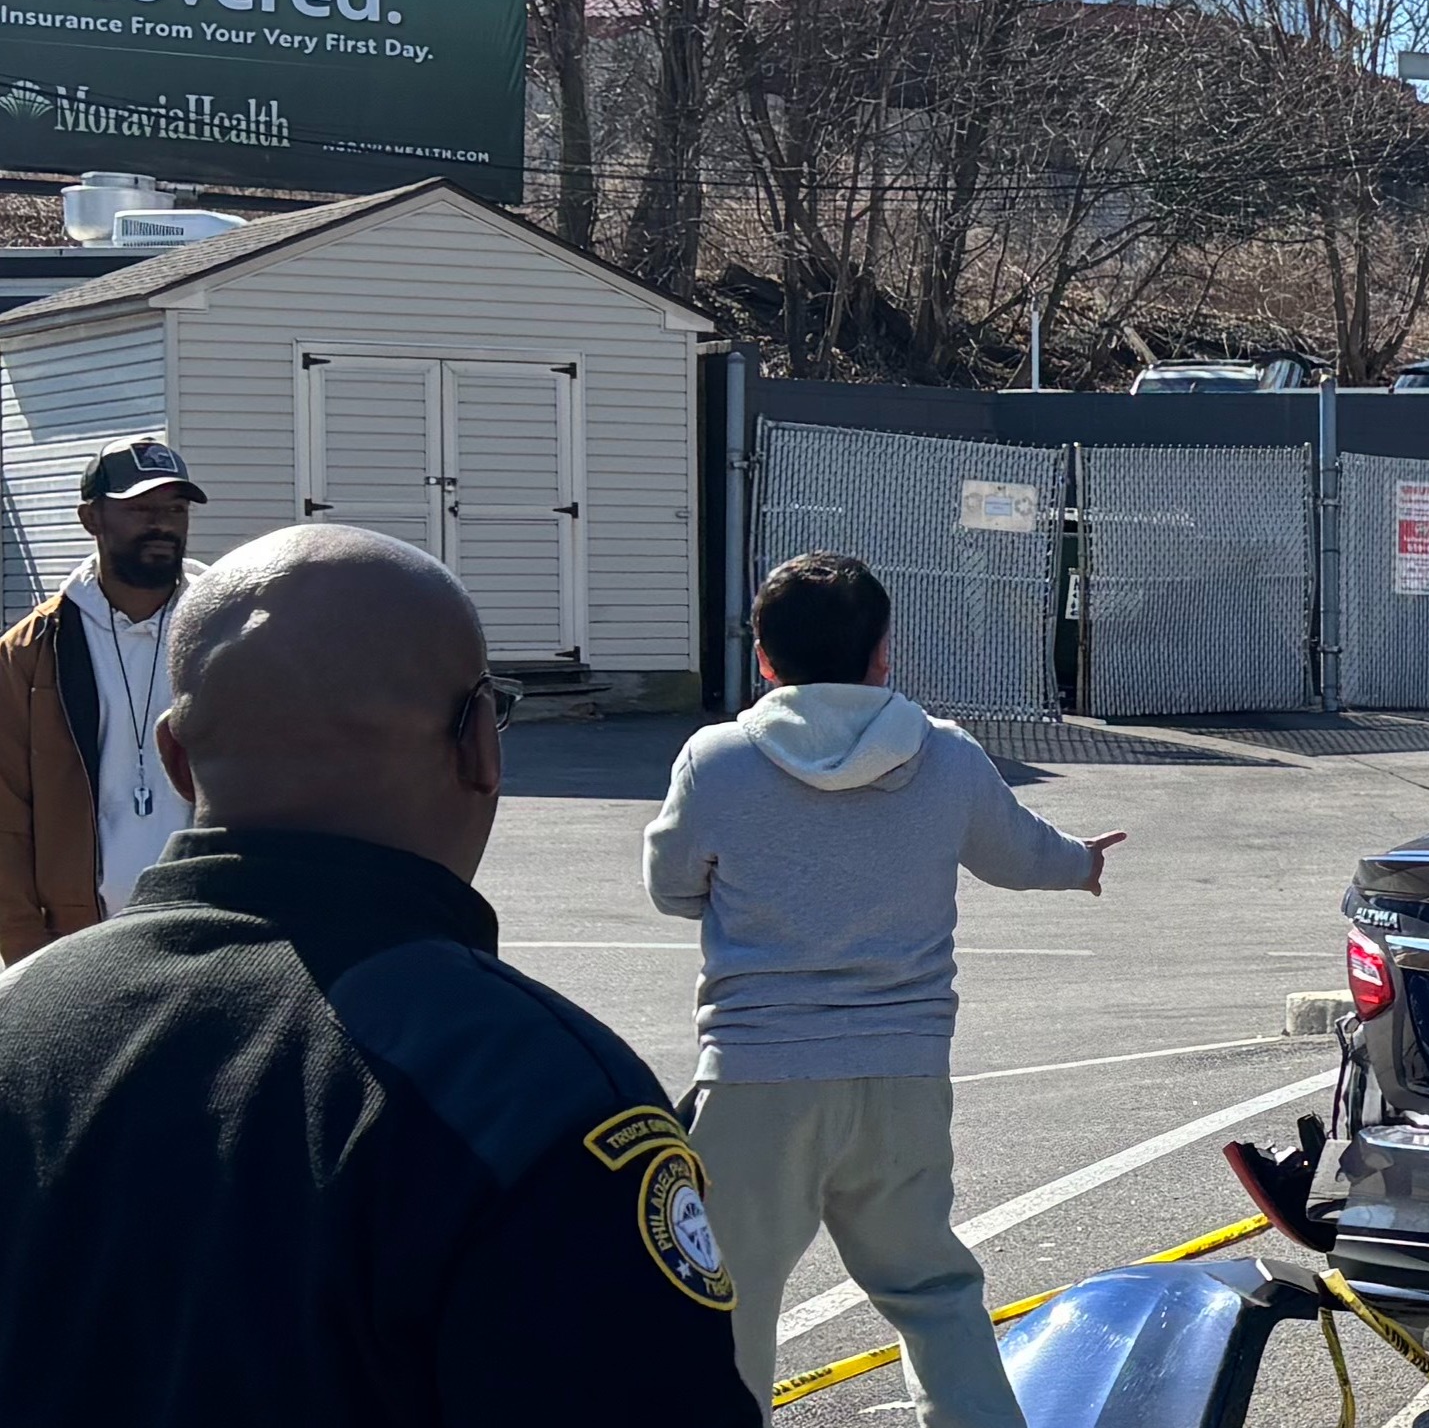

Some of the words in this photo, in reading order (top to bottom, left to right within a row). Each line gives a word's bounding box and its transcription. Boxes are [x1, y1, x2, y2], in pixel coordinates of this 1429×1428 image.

[1, 5, 123, 33] Insurance
[131, 16, 194, 39] From
[201, 22, 256, 44] Your
[263, 28, 318, 54] Very
[326, 33, 378, 55] First
[385, 39, 434, 63] Day.
[54, 85, 291, 147] MoraviaHealth
